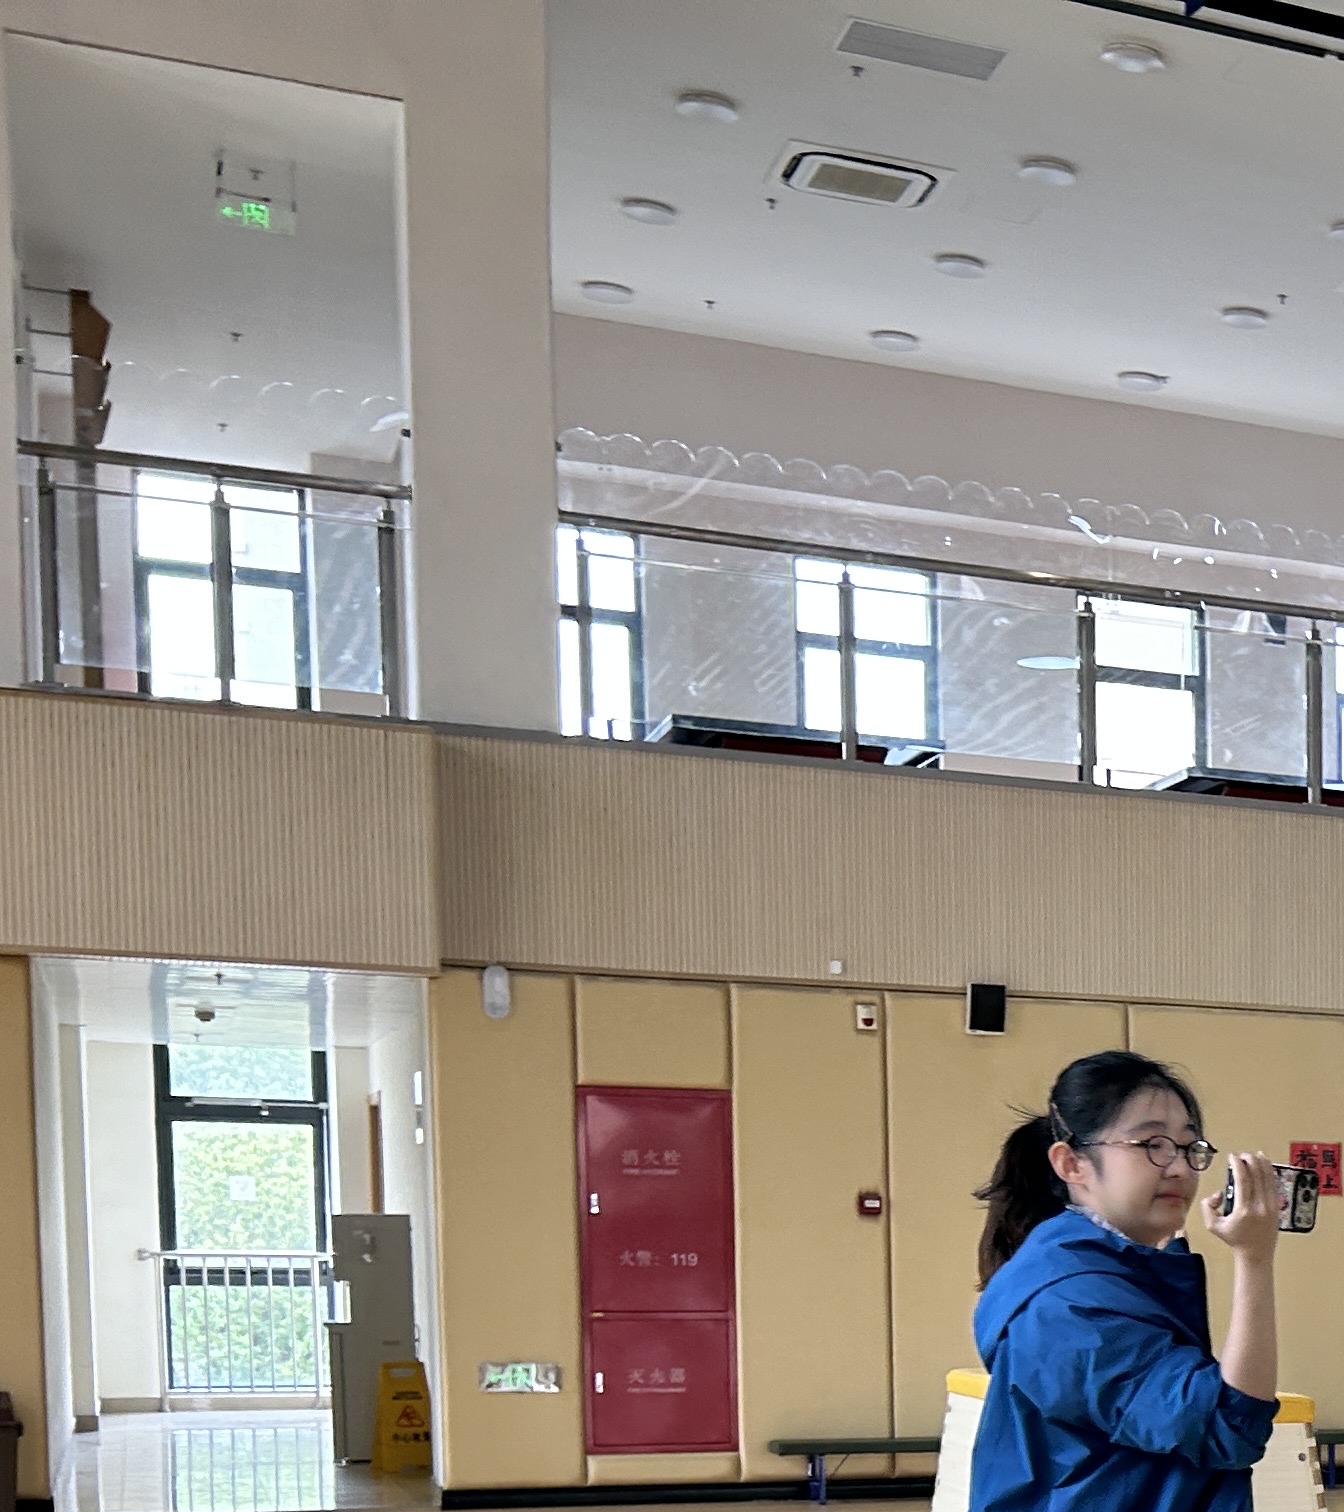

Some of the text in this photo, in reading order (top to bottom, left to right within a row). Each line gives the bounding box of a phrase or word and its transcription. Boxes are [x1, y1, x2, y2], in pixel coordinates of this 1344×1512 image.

[622, 1149, 682, 1166] 消火栓
[671, 1253, 699, 1267] 119
